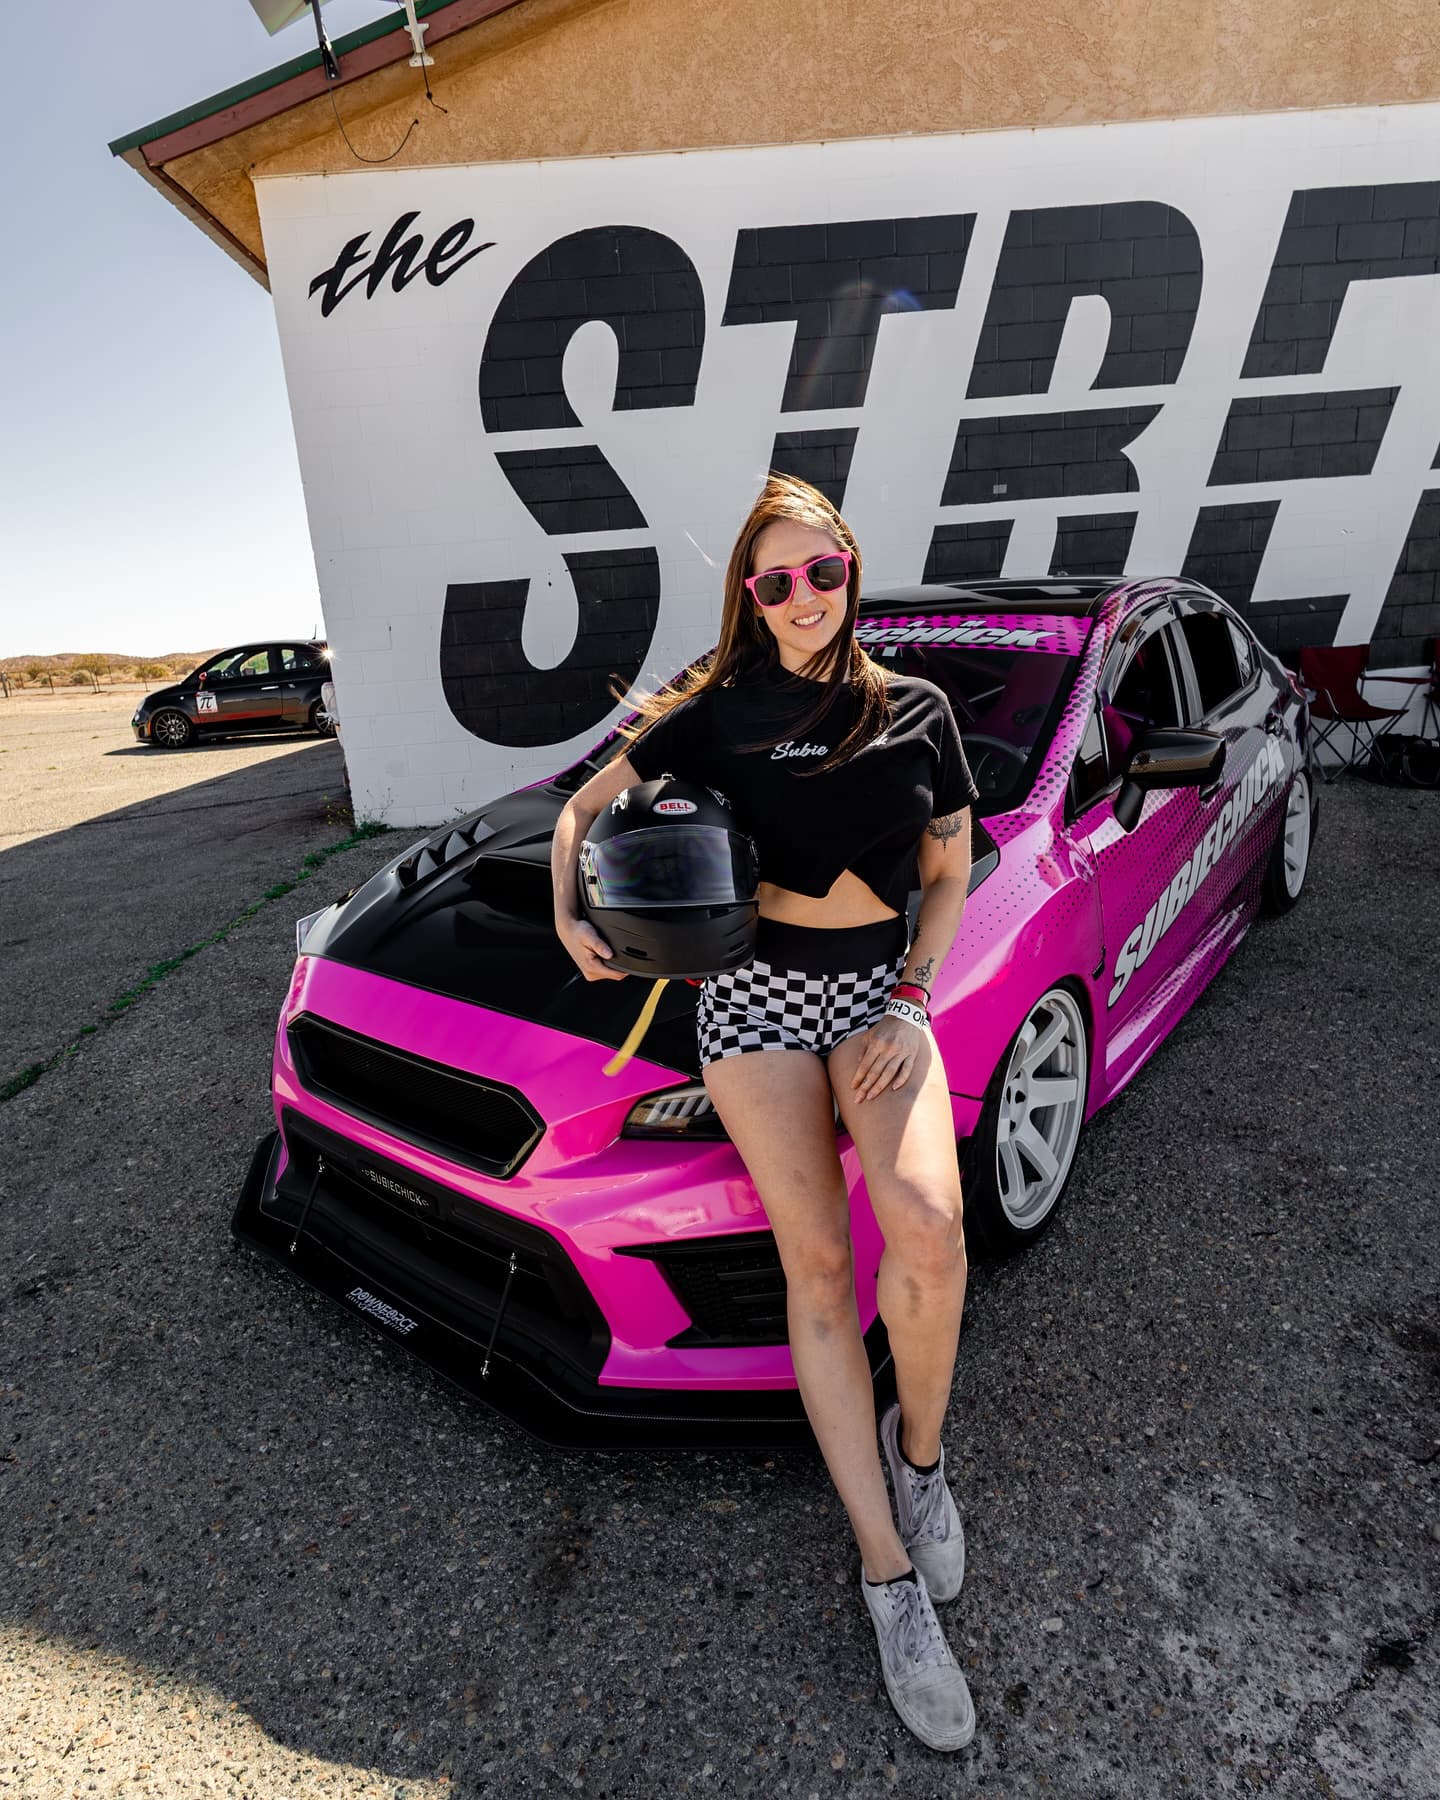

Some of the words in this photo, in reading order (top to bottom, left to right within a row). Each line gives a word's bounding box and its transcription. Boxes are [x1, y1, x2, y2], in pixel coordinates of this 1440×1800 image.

[308, 211, 498, 318] the
[440, 180, 1440, 748] STRE
[855, 627, 1058, 646] ECHICK
[770, 741, 829, 760] Subie
[659, 802, 691, 811] BELL
[1107, 732, 1286, 1008] SUBIECHICK
[369, 1170, 423, 1206] SUBIECHICK
[350, 1287, 419, 1332] DOWNFORCE
